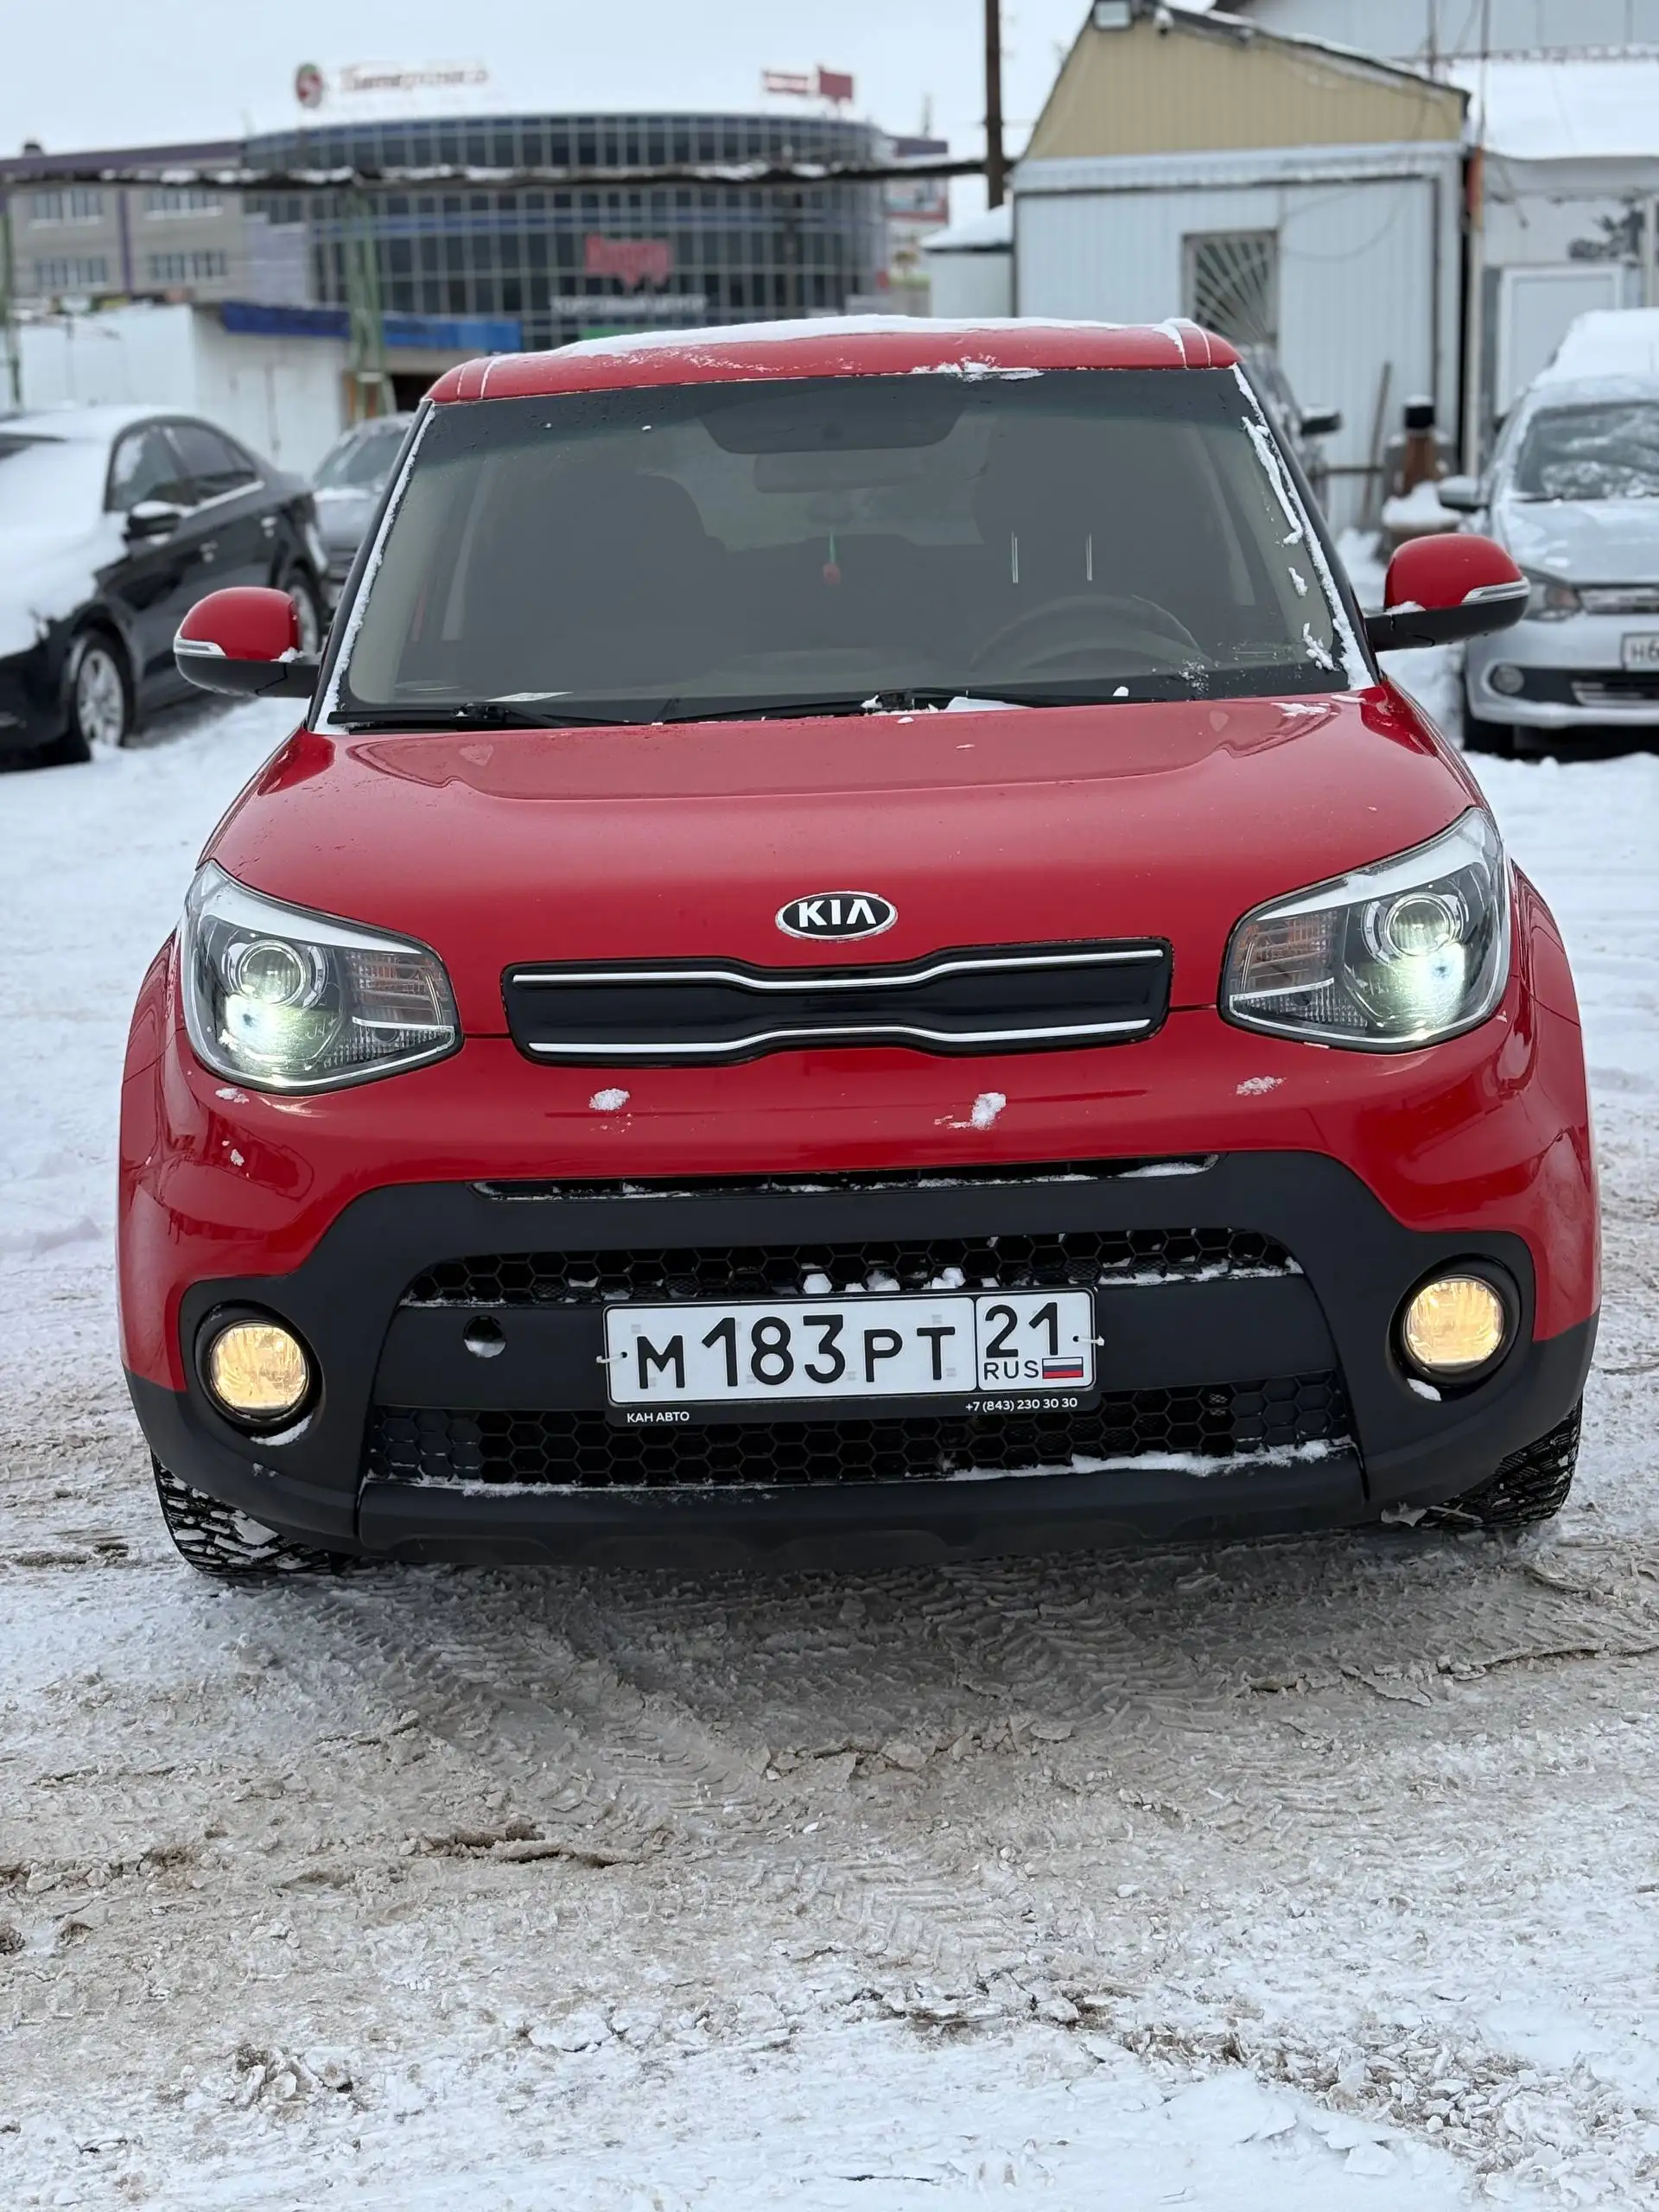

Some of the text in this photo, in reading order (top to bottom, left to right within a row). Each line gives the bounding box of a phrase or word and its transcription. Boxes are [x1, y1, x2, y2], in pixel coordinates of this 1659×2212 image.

[798, 899, 876, 927] KIA
[985, 1302, 1058, 1358] 21
[983, 1360, 1039, 1381] RUS
[965, 1397, 1078, 1413] +7 (843) 230 30 30
[626, 1411, 690, 1423] КАН АВТО
